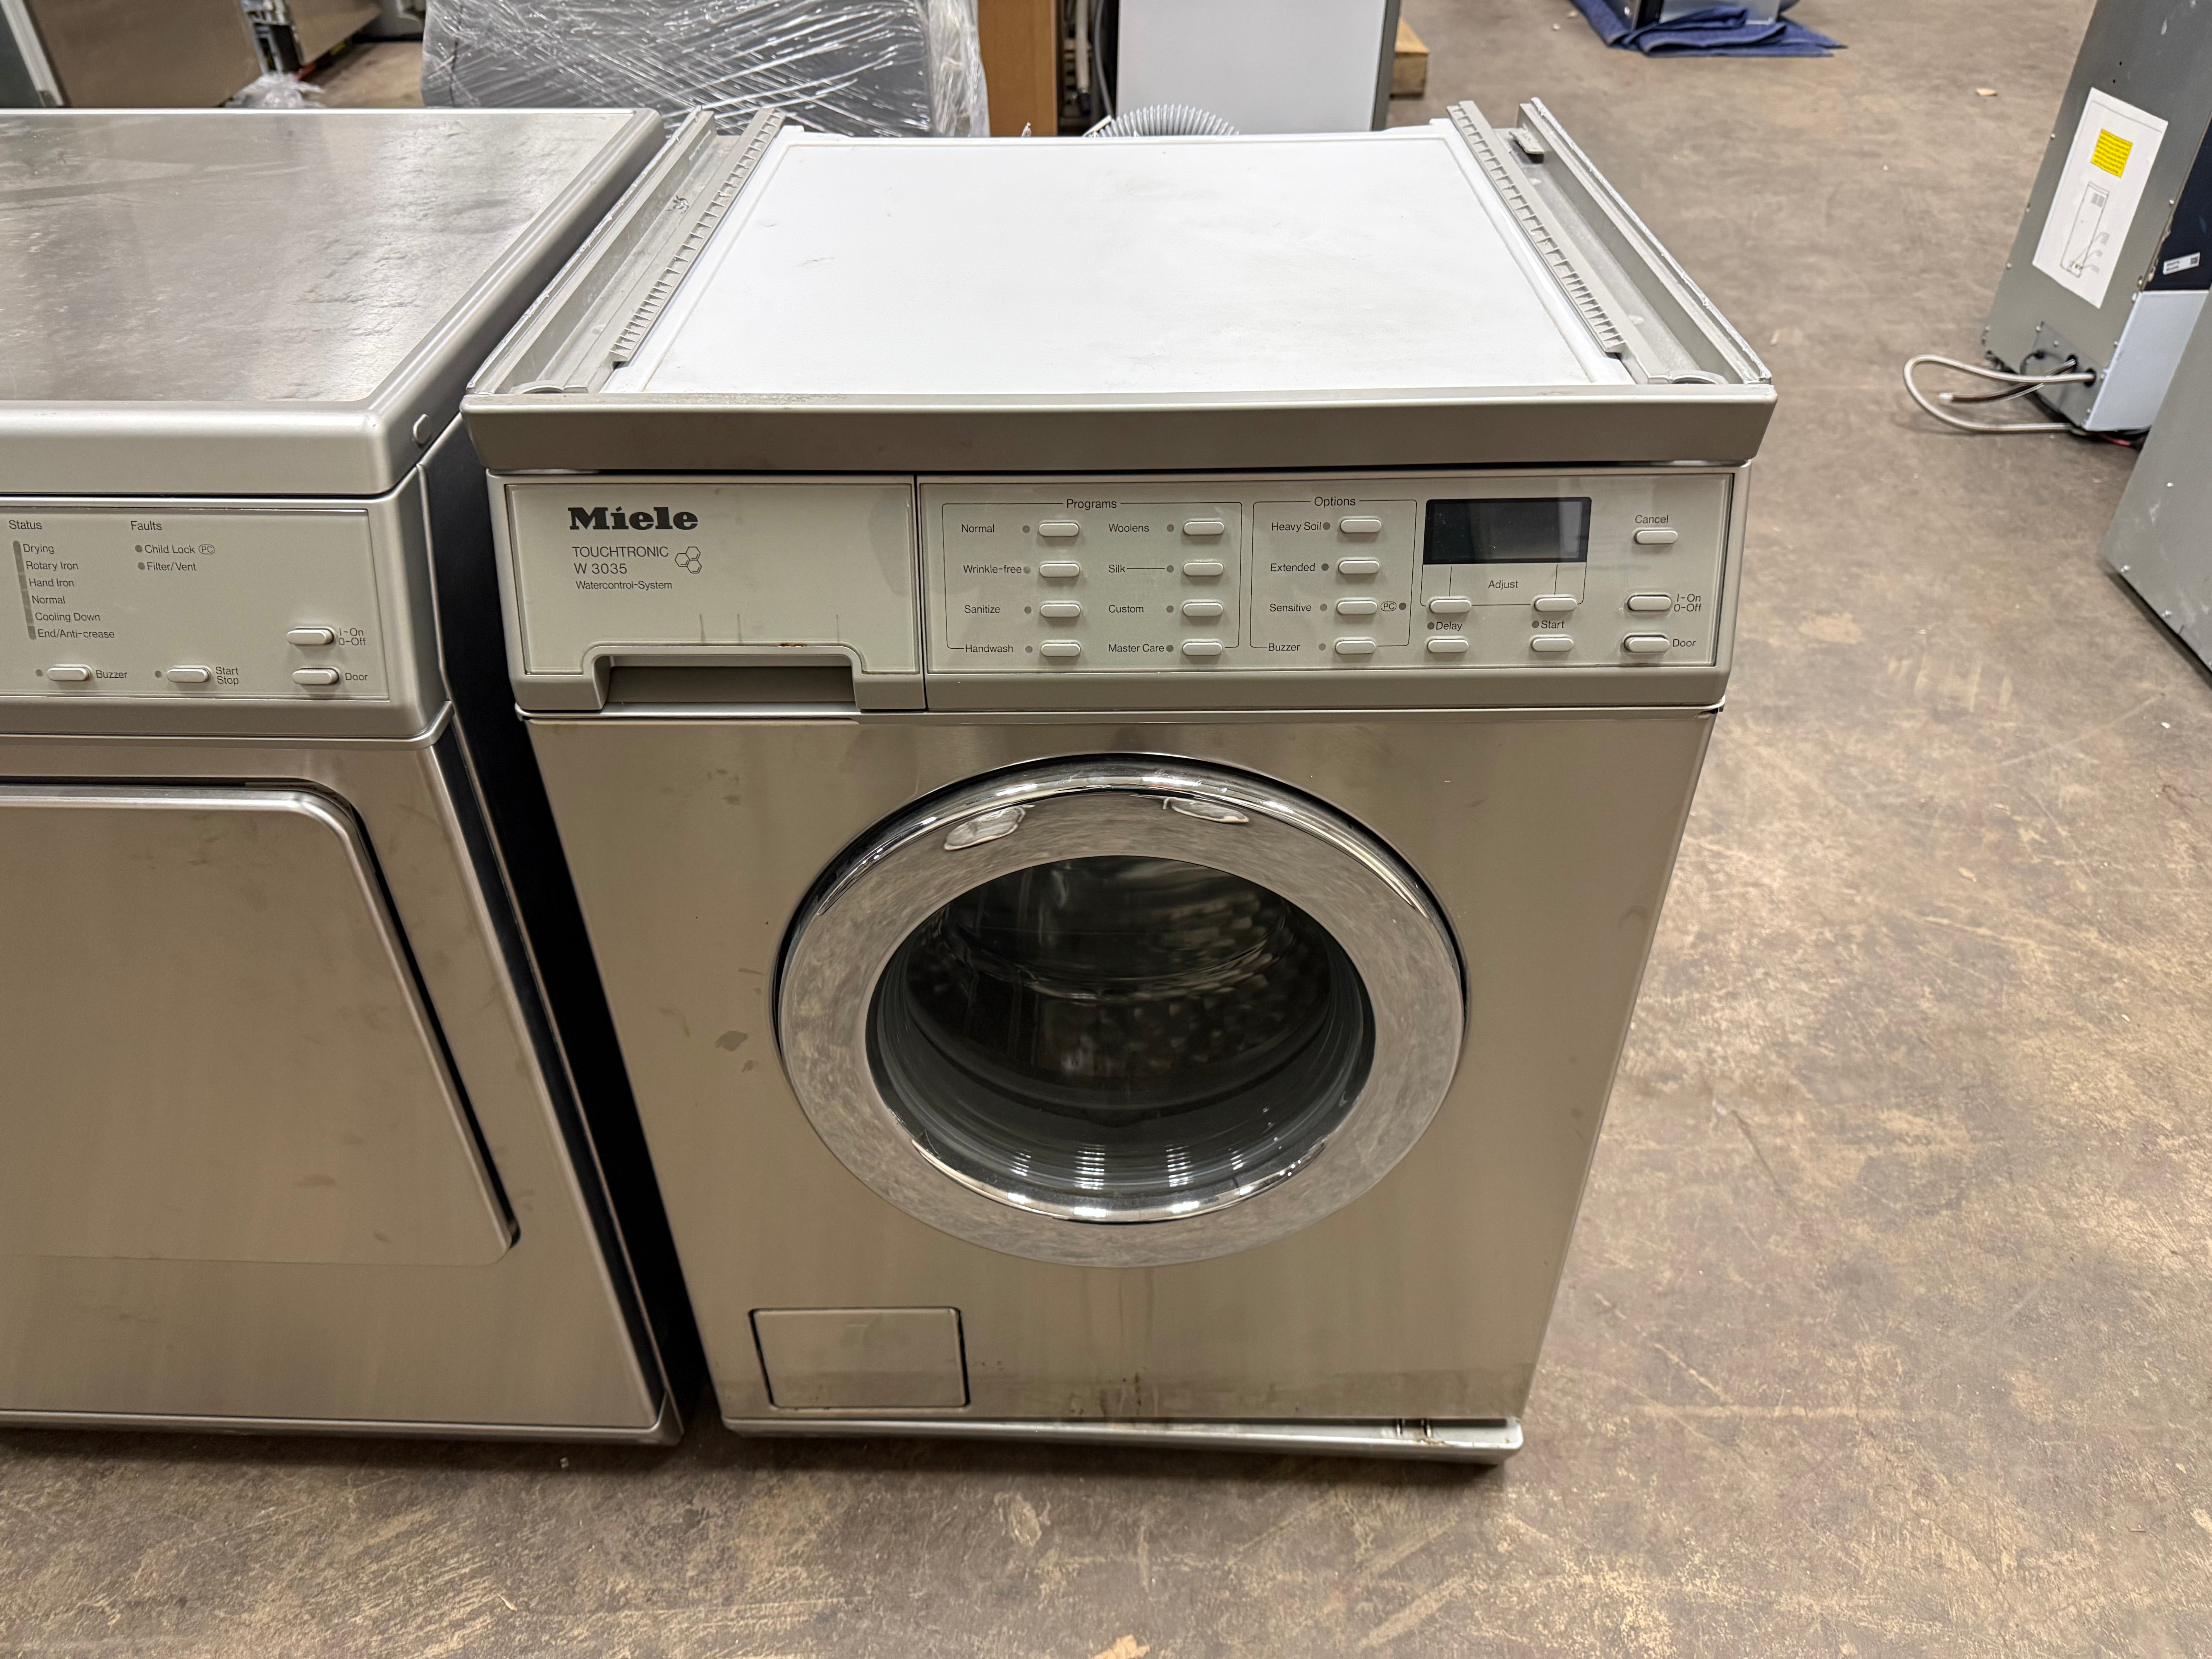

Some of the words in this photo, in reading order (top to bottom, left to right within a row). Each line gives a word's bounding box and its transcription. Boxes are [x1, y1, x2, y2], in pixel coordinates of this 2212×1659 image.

[1066, 499, 1117, 510] Programs
[1314, 496, 1356, 508] Options
[567, 506, 698, 531] Miele
[1635, 514, 1669, 524] Cancel
[9, 520, 42, 529] Status
[131, 520, 162, 531] Faults
[962, 524, 994, 533] Normal
[1108, 524, 1149, 532] Woolens
[1272, 522, 1302, 532] Heavy
[1304, 522, 1321, 531] Soil
[23, 544, 54, 555] Drying
[144, 544, 169, 553] Child
[172, 545, 196, 554] Lock
[572, 546, 669, 557] TOUCHTRONIC
[26, 561, 57, 572] Rotary
[60, 561, 79, 570] Iron
[573, 563, 587, 574] W
[591, 563, 627, 574] 3035
[963, 565, 1022, 574] Wrinkle-free
[1108, 564, 1125, 573] Silk
[1270, 563, 1315, 572] Extended
[29, 578, 54, 587] Hand
[56, 578, 74, 587] Iron
[575, 580, 672, 591] Watercontrol-System
[1488, 580, 1518, 590] Adjust
[32, 595, 65, 604] Normal
[964, 605, 1000, 613] Sanitize
[1108, 605, 1144, 613] Custom
[1269, 603, 1312, 612] Sensitive
[1383, 602, 1395, 610] PC
[35, 612, 71, 623] Cooling
[73, 612, 100, 621] Down
[1436, 621, 1463, 632] Delay
[1540, 620, 1565, 629] Start
[37, 629, 115, 638] End/Anti-crease
[1268, 643, 1300, 651] Buzzer
[1673, 639, 1697, 647] Door
[965, 644, 1013, 653] Handwash
[1109, 644, 1140, 652] Master
[1142, 644, 1164, 652] Care
[96, 670, 127, 678] Buzzer
[215, 666, 239, 675] Start
[217, 675, 239, 686] Stop
[345, 672, 368, 681] Door
